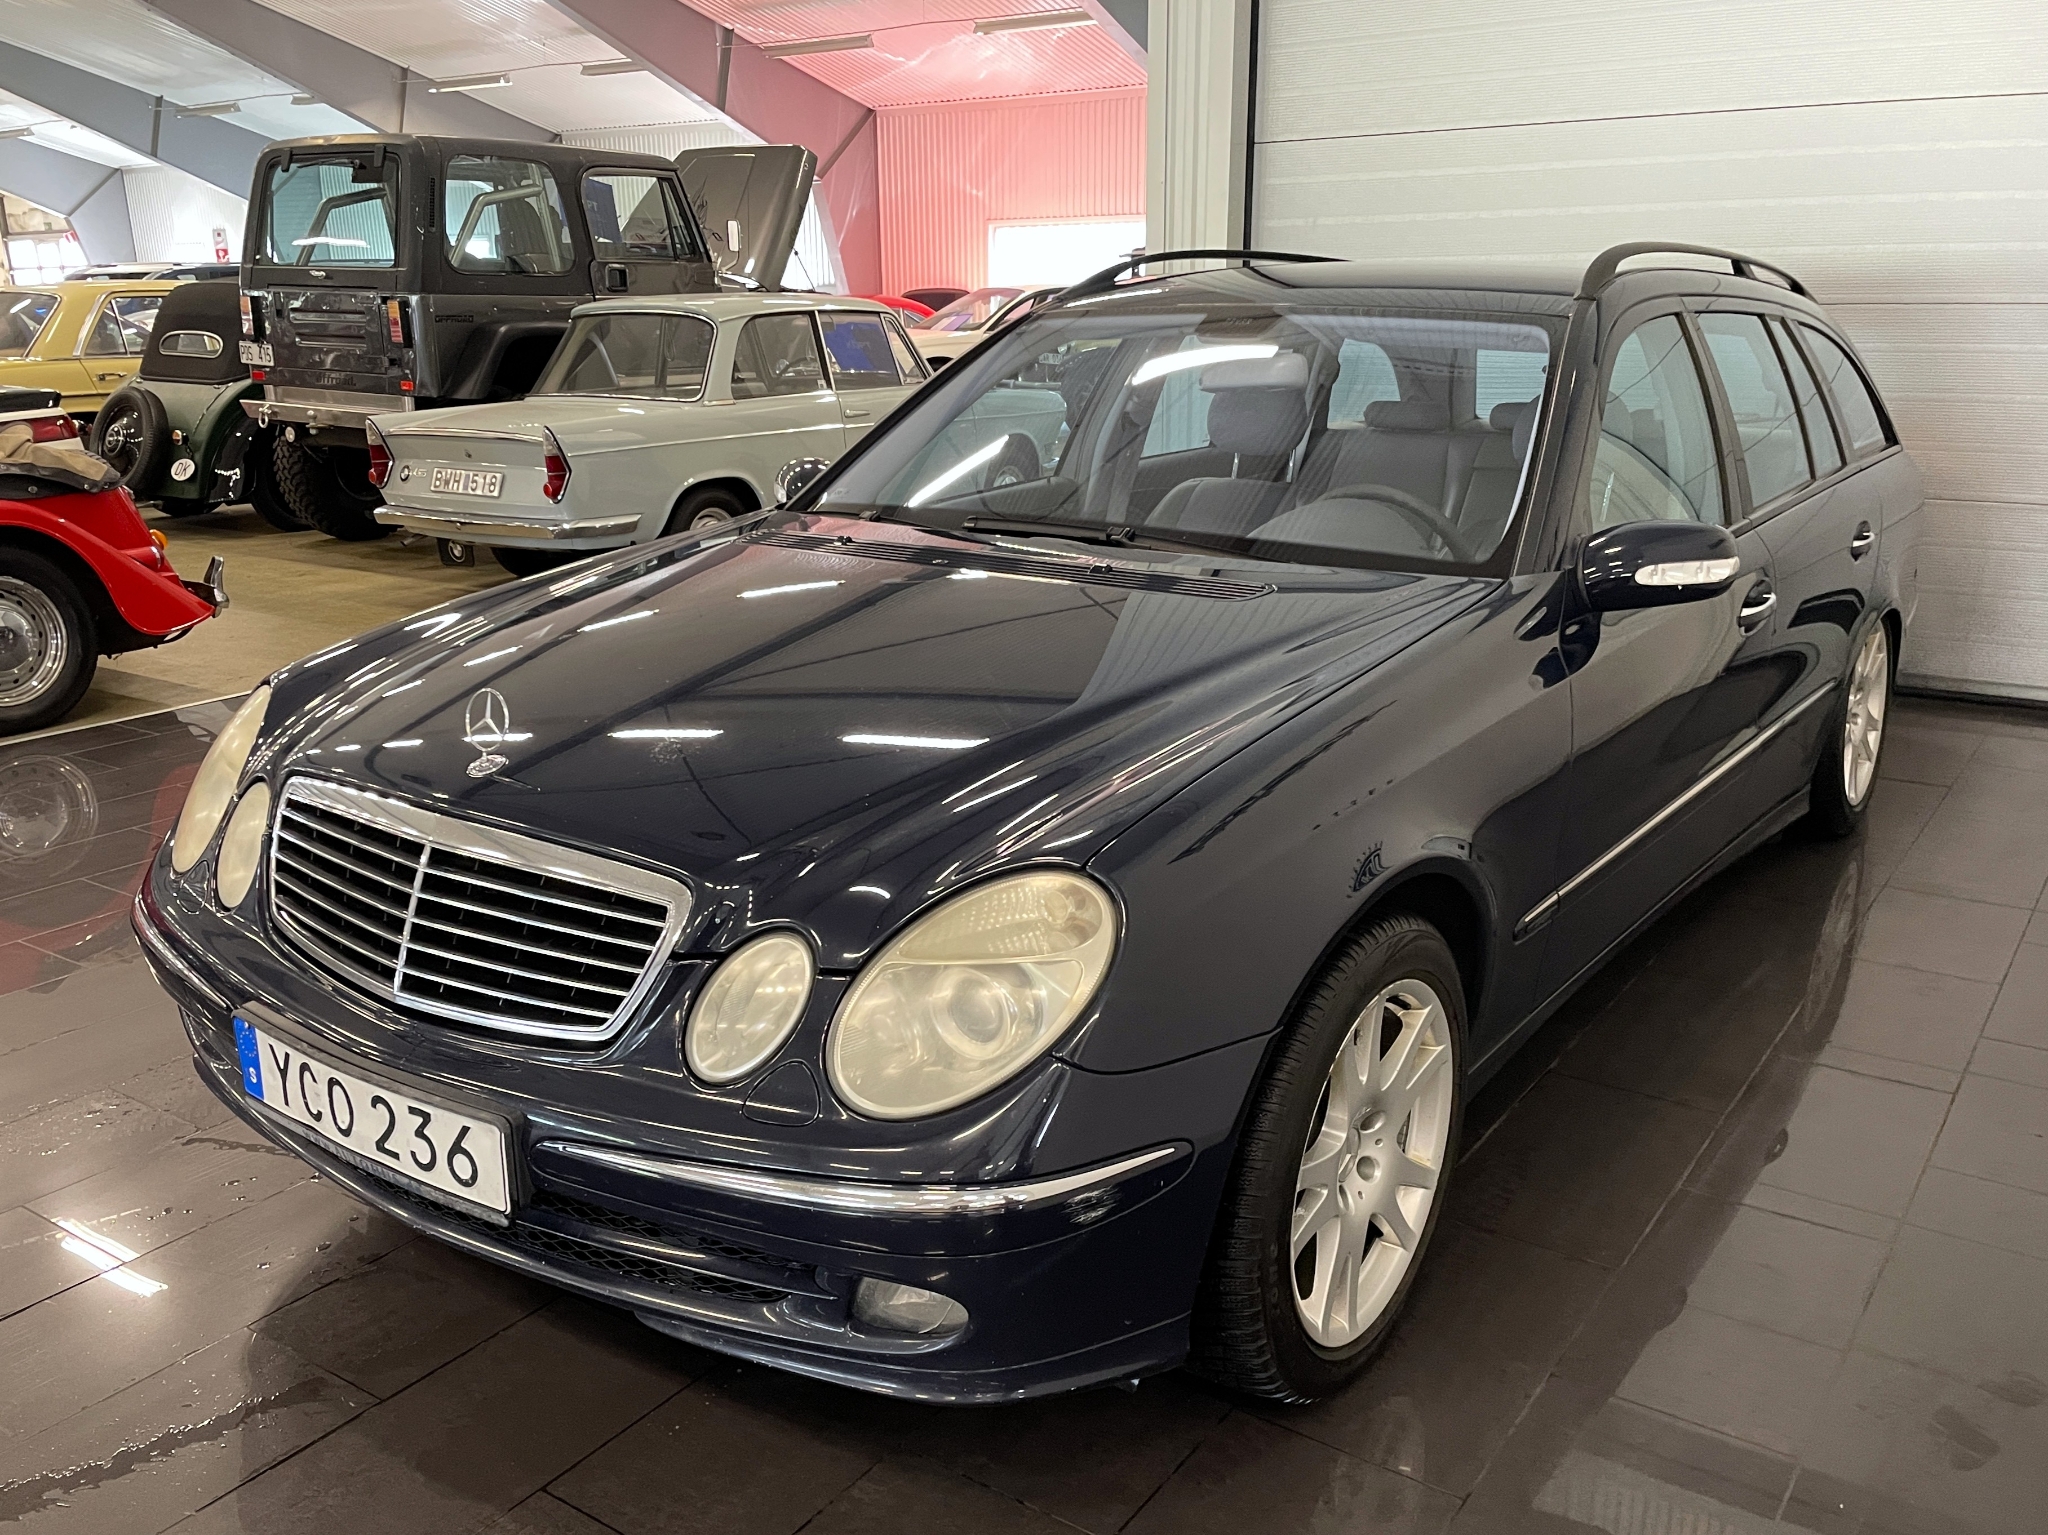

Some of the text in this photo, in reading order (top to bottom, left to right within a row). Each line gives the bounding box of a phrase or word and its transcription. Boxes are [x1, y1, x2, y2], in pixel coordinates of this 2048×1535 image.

[174, 461, 191, 478] DK
[433, 469, 499, 494] BWH 518
[248, 1066, 258, 1084] S
[268, 1042, 479, 1189] YCO 236
